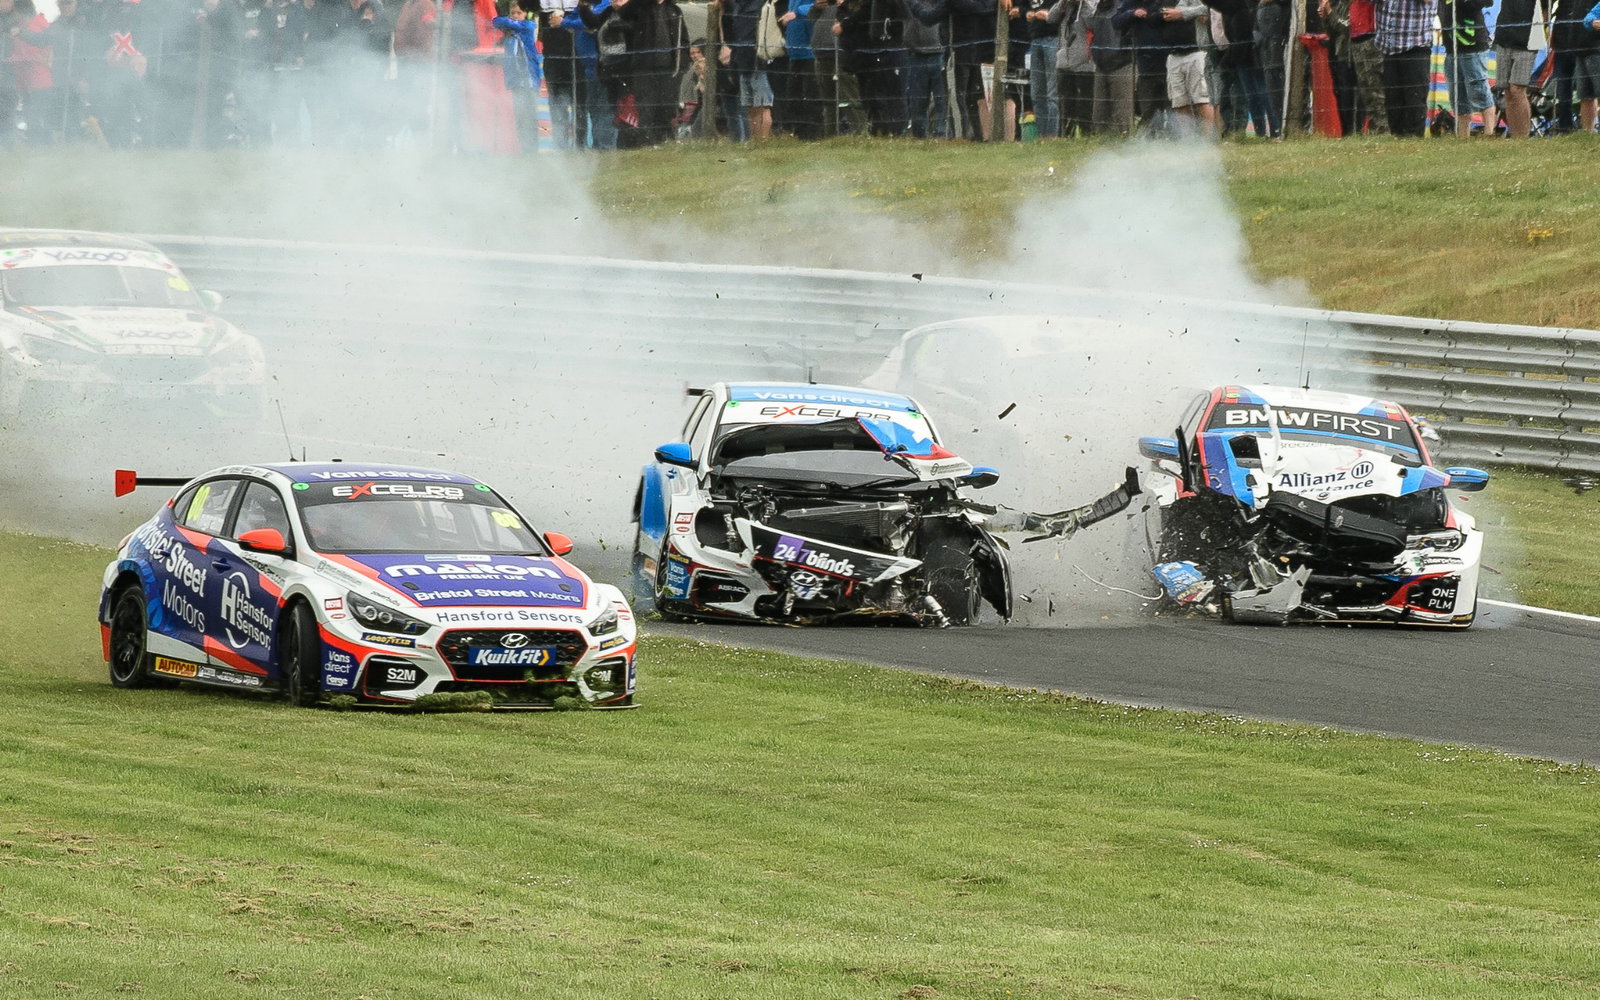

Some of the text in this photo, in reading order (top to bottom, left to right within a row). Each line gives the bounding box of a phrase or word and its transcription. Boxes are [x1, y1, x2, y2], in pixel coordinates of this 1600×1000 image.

[44, 251, 128, 262] YAZOO
[1278, 472, 1346, 488] Allianz
[332, 482, 465, 499] EXCELR8
[166, 542, 207, 598] Street
[414, 589, 473, 601] Bristol
[474, 588, 530, 599] Street
[531, 590, 581, 603] Motors
[1432, 587, 1456, 598] ONE
[163, 579, 205, 633] Motors
[237, 590, 274, 631] Hansfor
[1428, 598, 1453, 610] PLM
[436, 610, 583, 624] Hansford Sensors
[328, 650, 351, 663] Vans
[324, 662, 351, 674] direct
[387, 667, 416, 681] S2M
